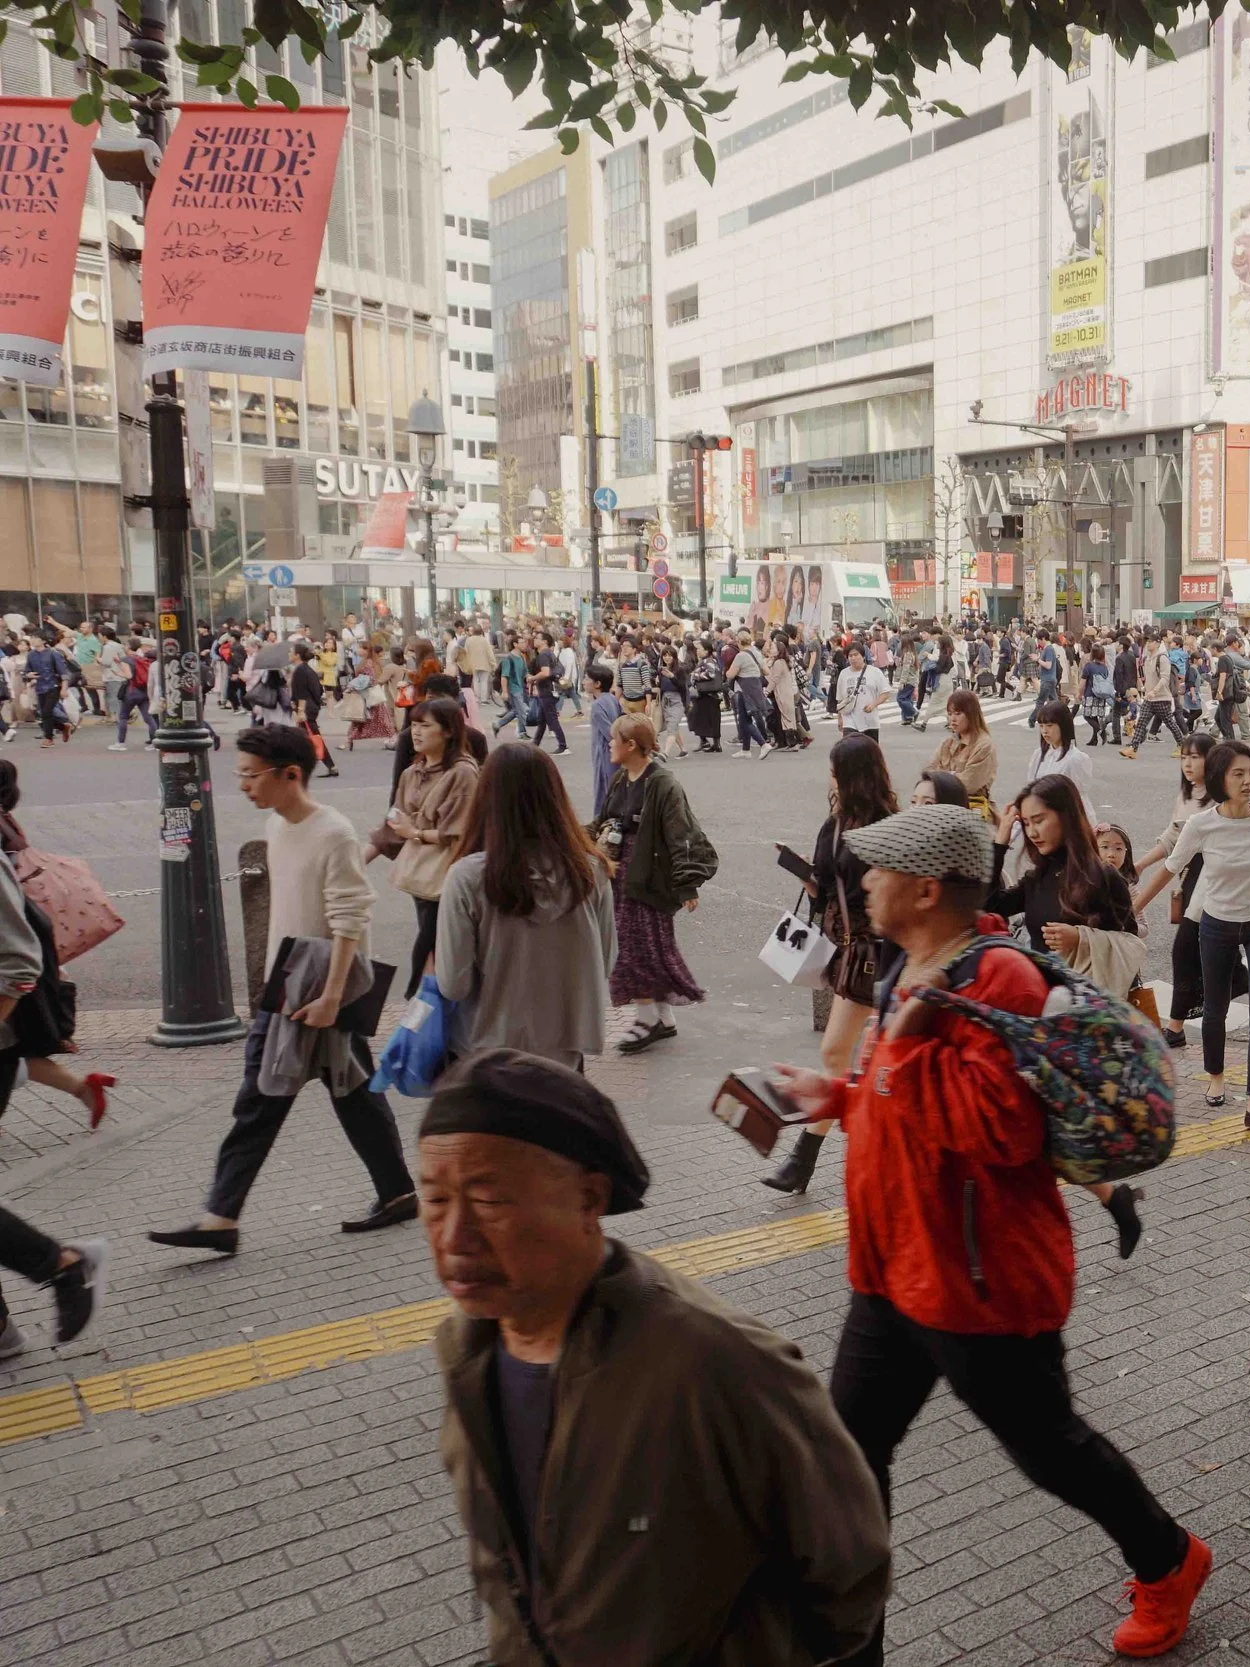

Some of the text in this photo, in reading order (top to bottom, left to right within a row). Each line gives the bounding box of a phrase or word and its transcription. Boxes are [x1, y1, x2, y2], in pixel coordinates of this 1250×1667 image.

[192, 127, 316, 149] SHIBUYA
[183, 146, 316, 176] PRIDE
[176, 173, 305, 198] SHIBUYA
[171, 194, 304, 214] HALLOWEEN
[163, 219, 296, 242] ハロウィーンを
[160, 241, 290, 267] 渋谷の誇りに
[1058, 265, 1098, 286] BATMAN
[1063, 292, 1092, 307] MAGNET
[1036, 373, 1129, 425] MAGNET
